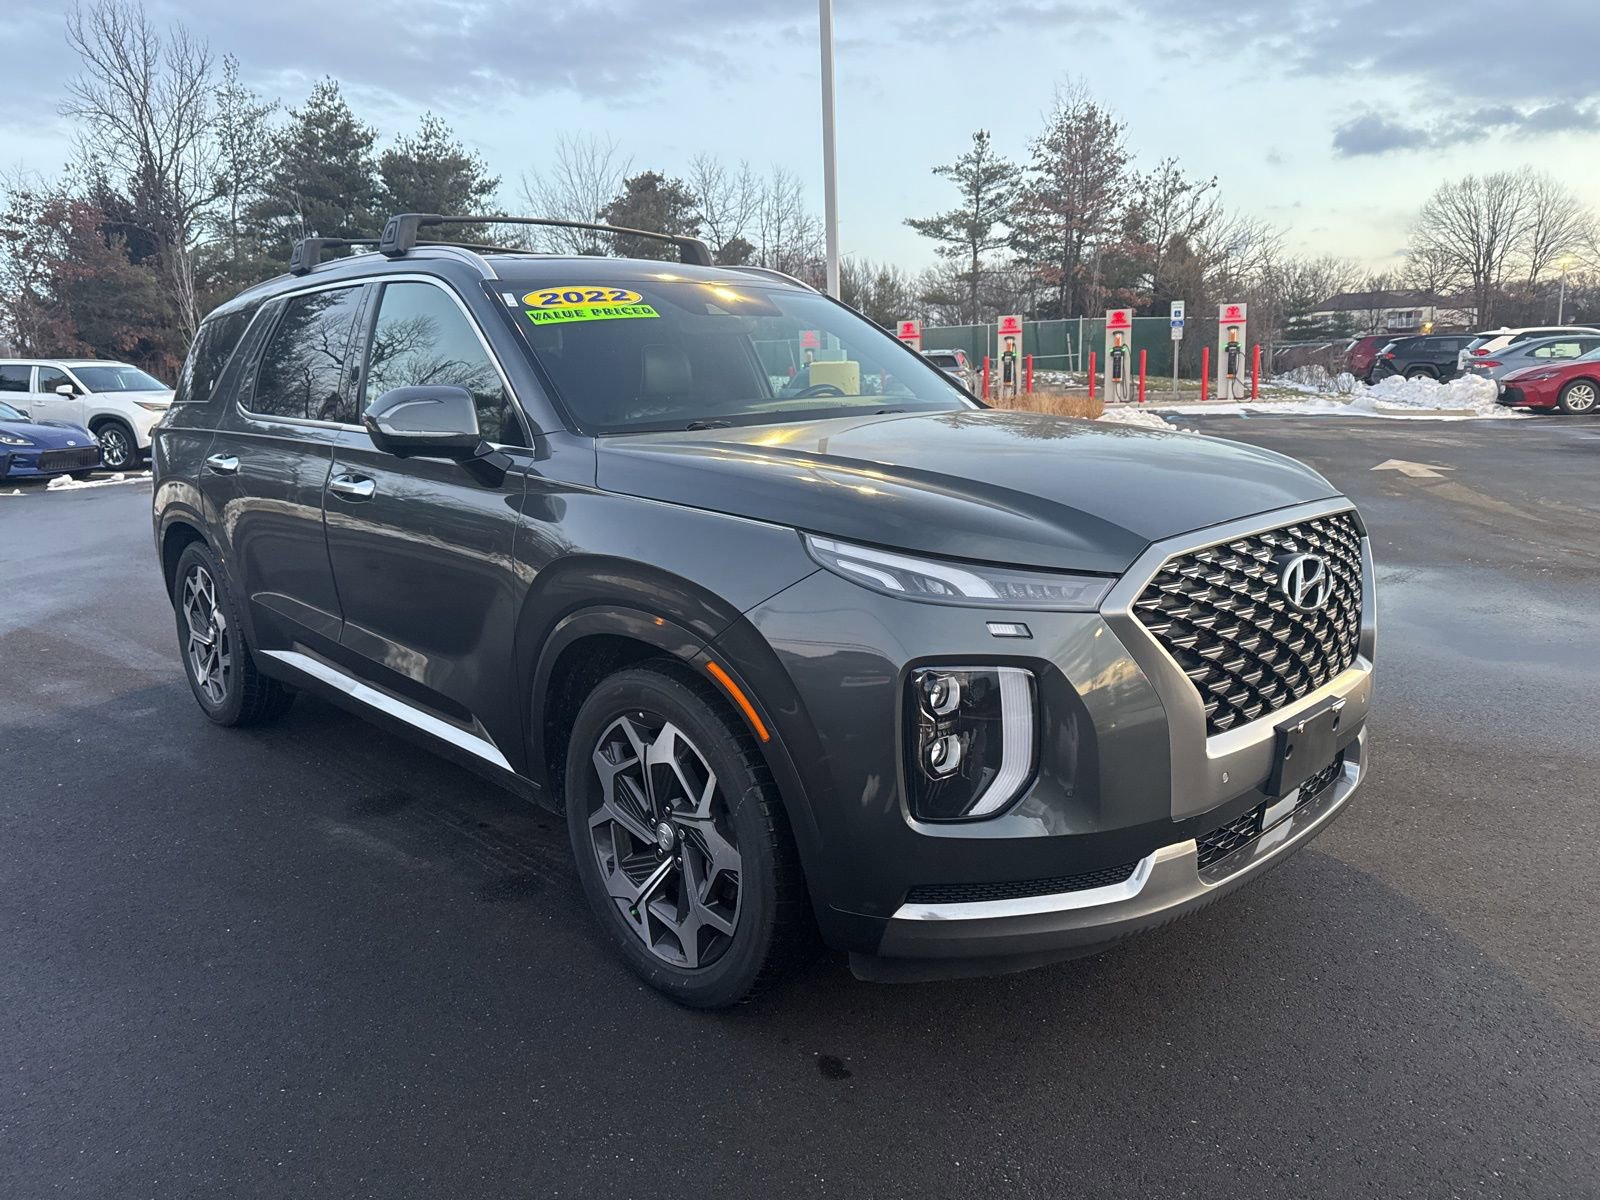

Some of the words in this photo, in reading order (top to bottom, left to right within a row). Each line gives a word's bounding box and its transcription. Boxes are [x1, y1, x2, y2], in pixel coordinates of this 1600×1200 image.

[539, 290, 631, 305] 2022
[530, 309, 585, 321] VALUE
[592, 306, 655, 316] PRICED
